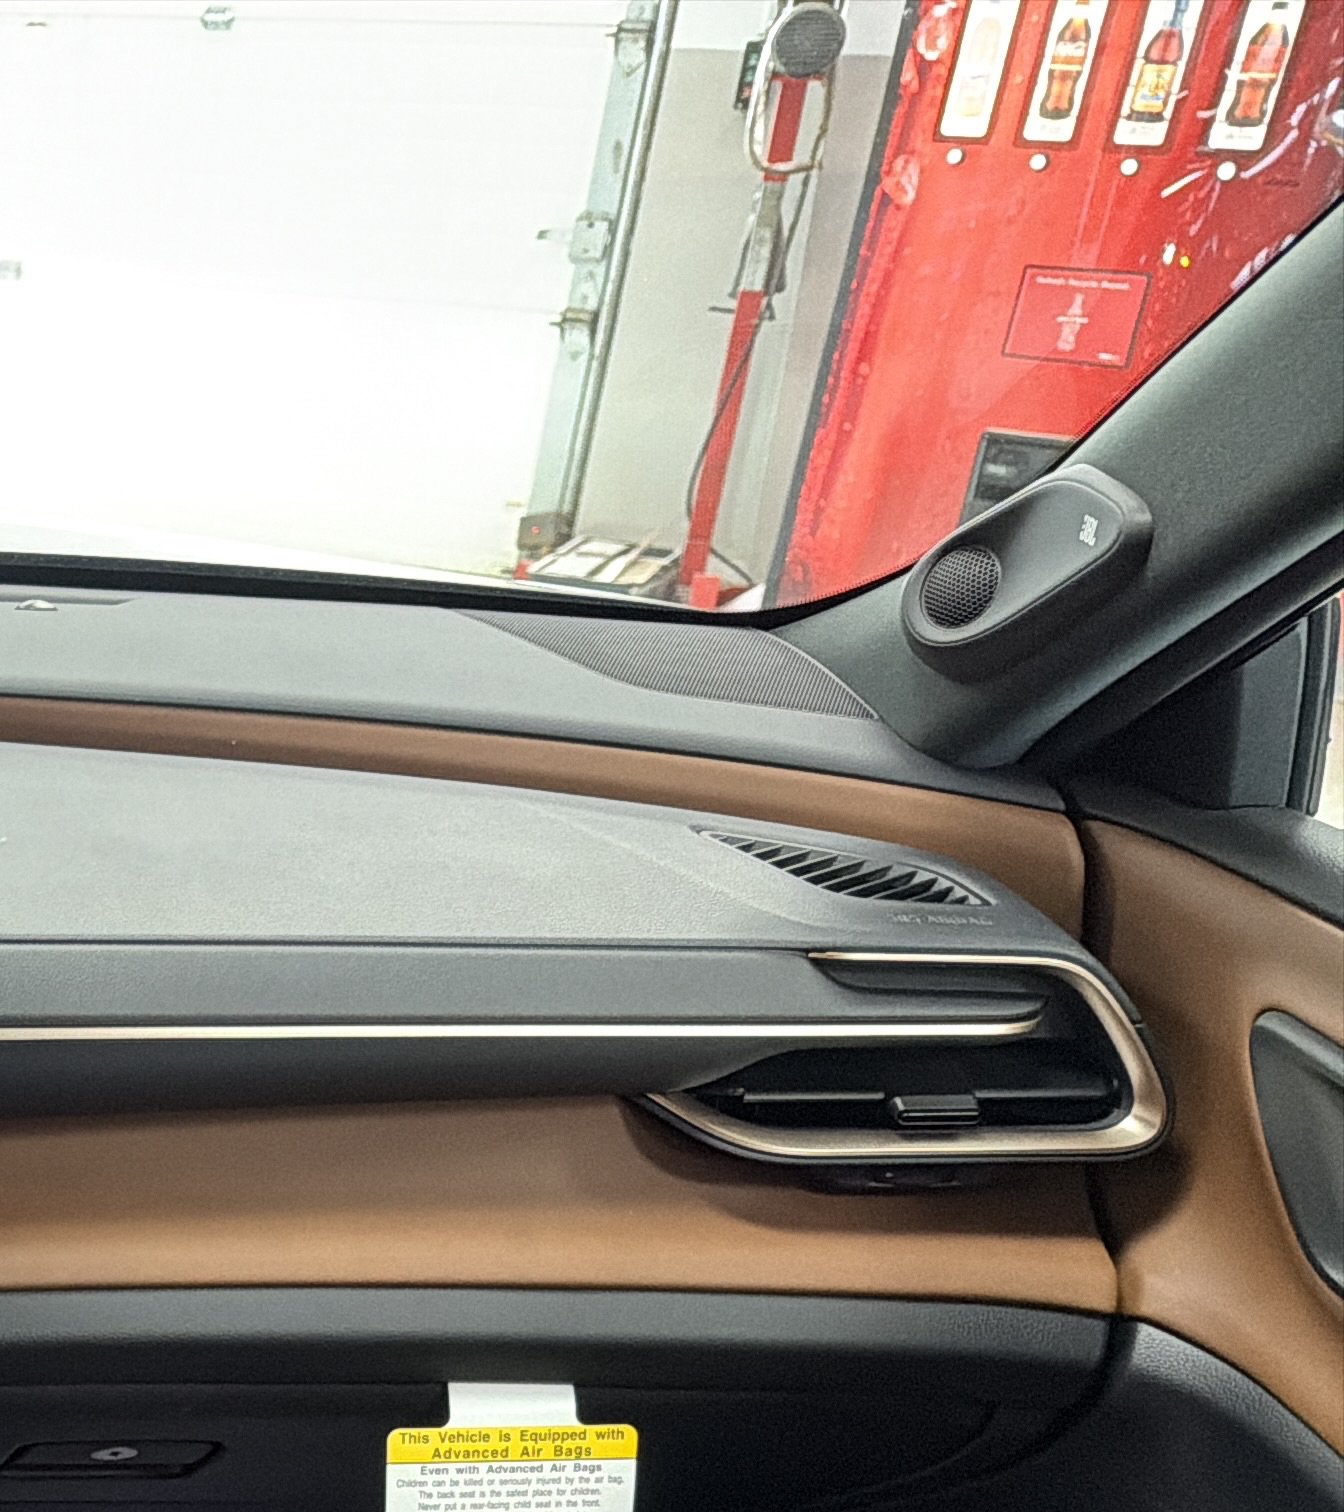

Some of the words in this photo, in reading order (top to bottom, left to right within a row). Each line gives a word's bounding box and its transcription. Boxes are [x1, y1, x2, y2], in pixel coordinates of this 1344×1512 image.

[399, 1432, 429, 1444] This
[438, 1430, 490, 1443] Vehicle
[499, 1430, 511, 1442] is
[520, 1429, 587, 1444] Equipped
[595, 1428, 624, 1440] with
[432, 1446, 509, 1459] Advanced
[520, 1446, 543, 1458] Air
[554, 1445, 592, 1459] Bags
[420, 1466, 449, 1475] Even
[455, 1465, 479, 1474] with
[486, 1463, 543, 1474] Advanced
[550, 1463, 567, 1473] Air
[573, 1463, 602, 1474] Bags
[396, 1479, 428, 1488] Children
[450, 1478, 459, 1487] be
[418, 1490, 433, 1499] The
